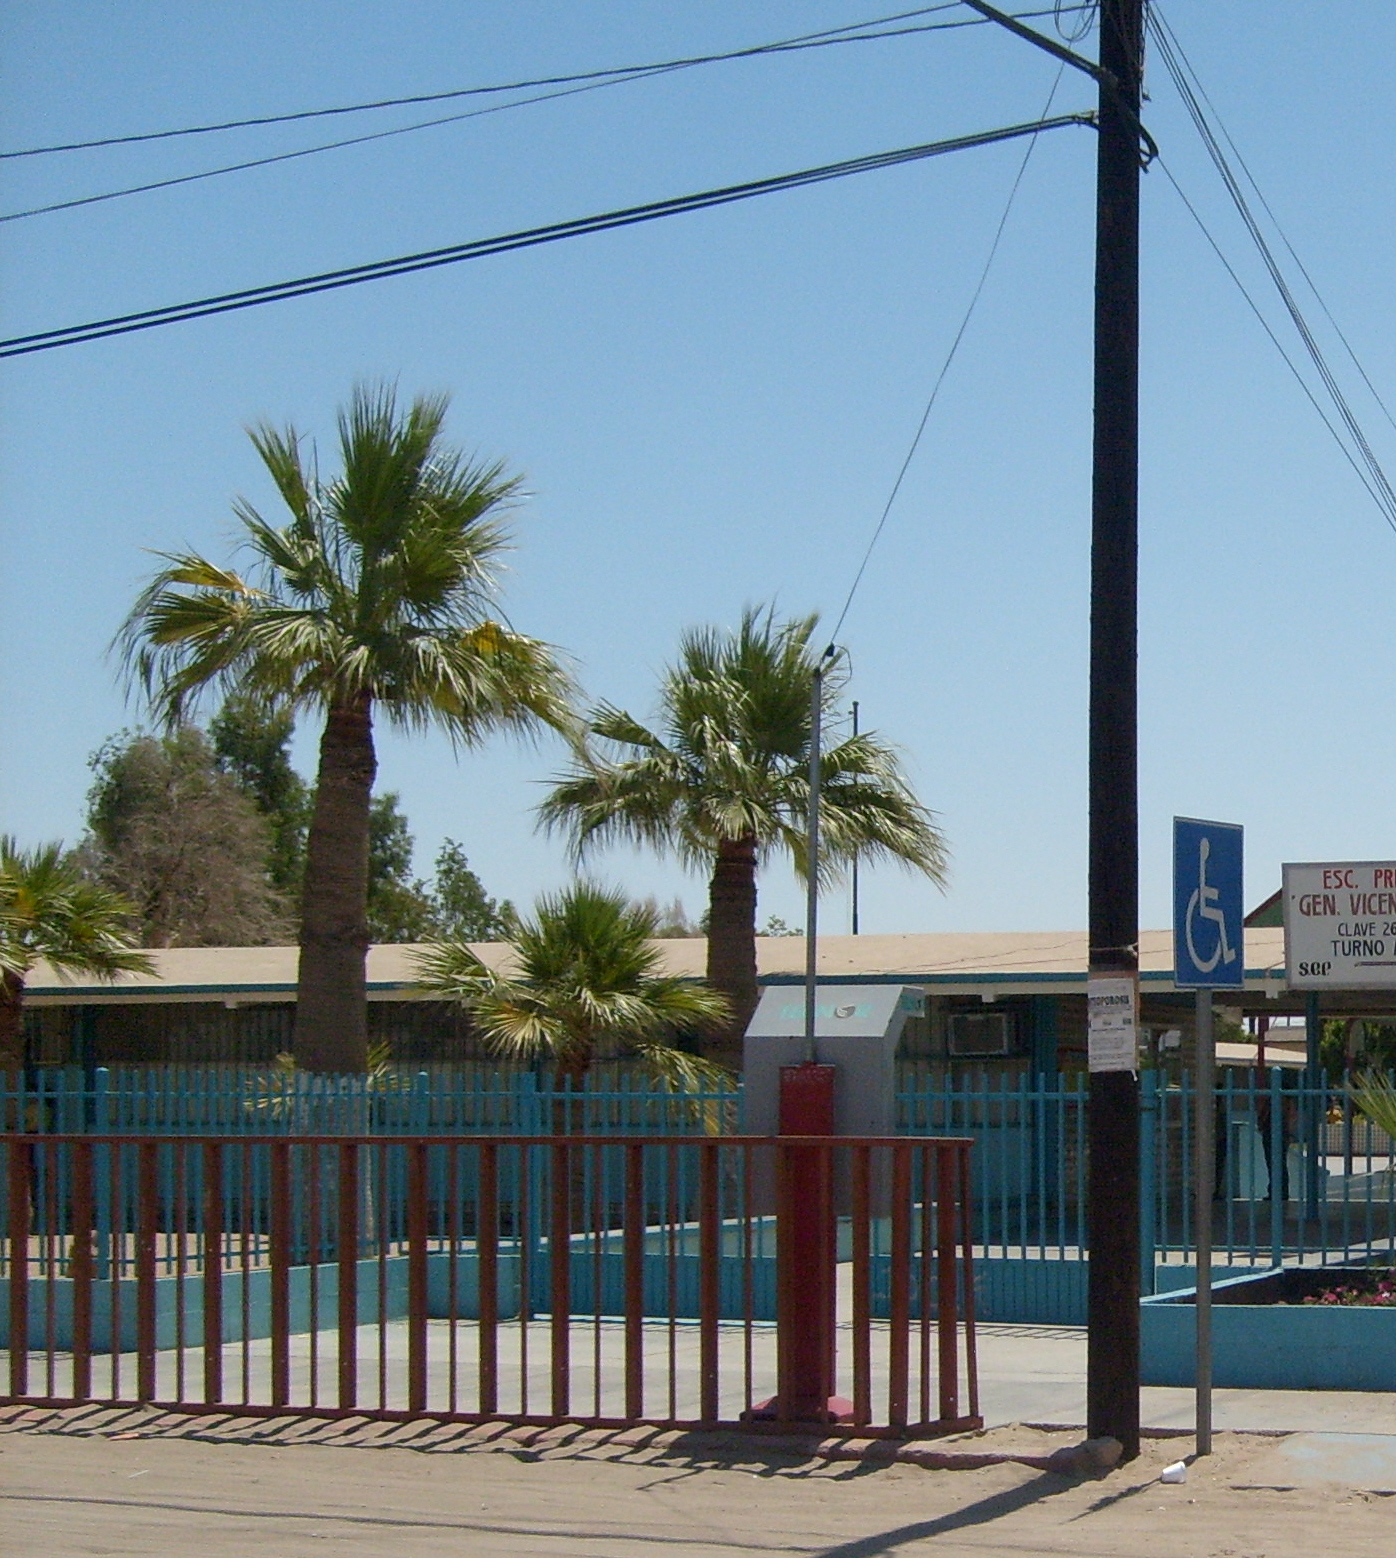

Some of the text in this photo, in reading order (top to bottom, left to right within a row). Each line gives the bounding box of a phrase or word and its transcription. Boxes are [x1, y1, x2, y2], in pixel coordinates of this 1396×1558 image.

[1323, 869, 1359, 889] ESC.
[1299, 894, 1341, 916] GEN.
[1337, 922, 1376, 937] CLAVE
[1331, 940, 1385, 956] TURNO
